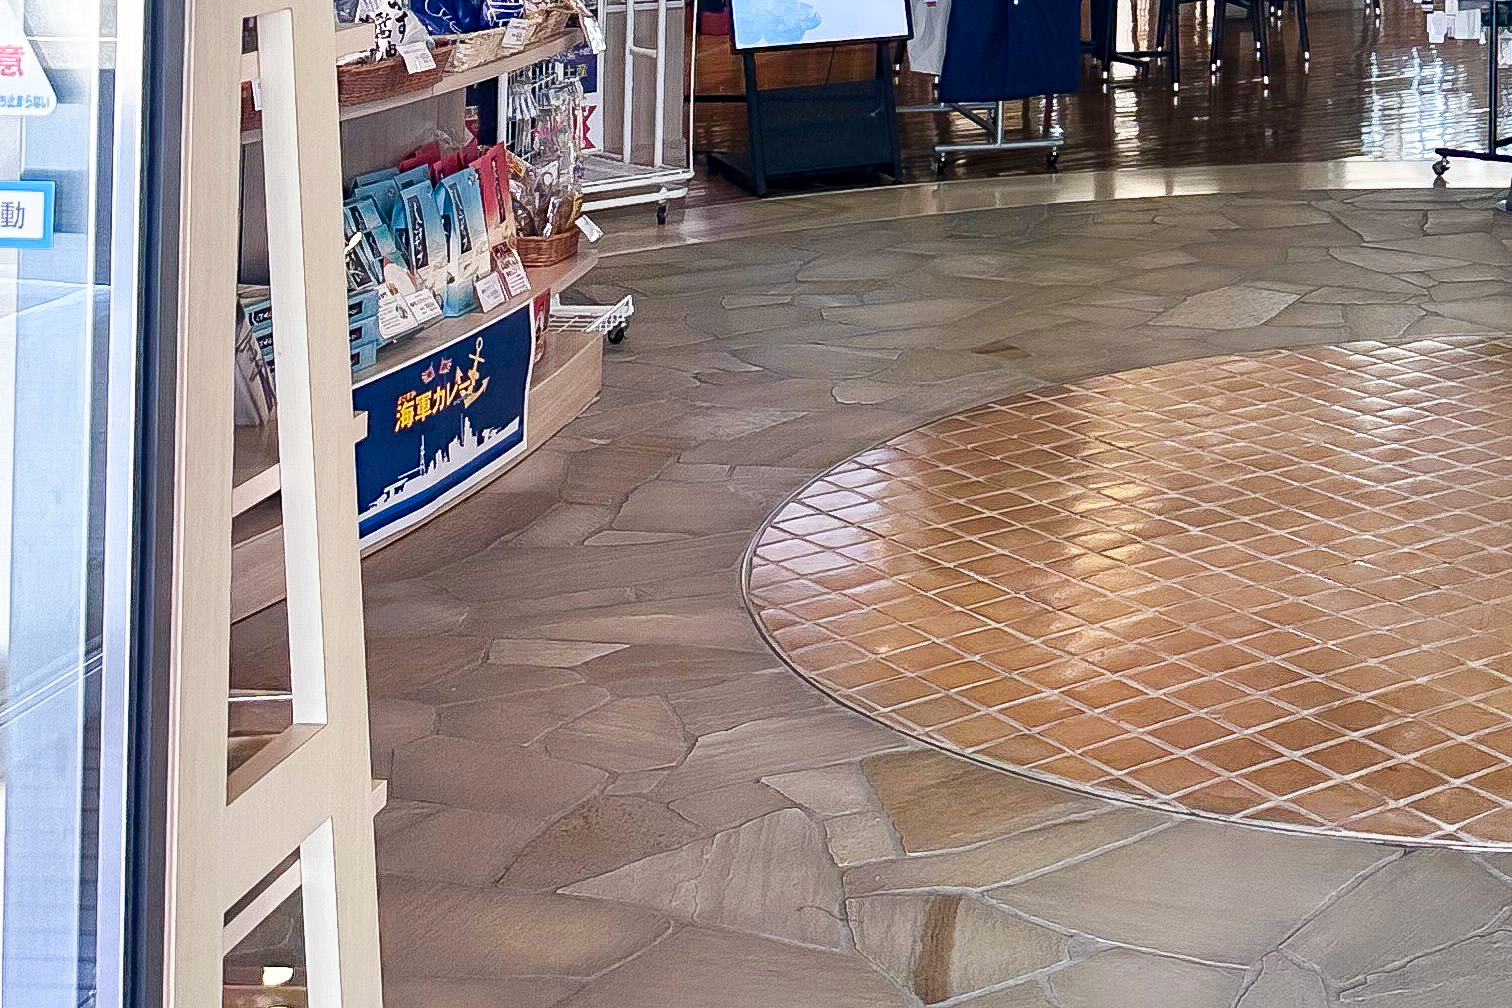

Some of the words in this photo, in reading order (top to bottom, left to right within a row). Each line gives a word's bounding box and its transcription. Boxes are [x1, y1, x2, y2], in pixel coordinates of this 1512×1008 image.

[394, 380, 472, 433] 海軍カレー
